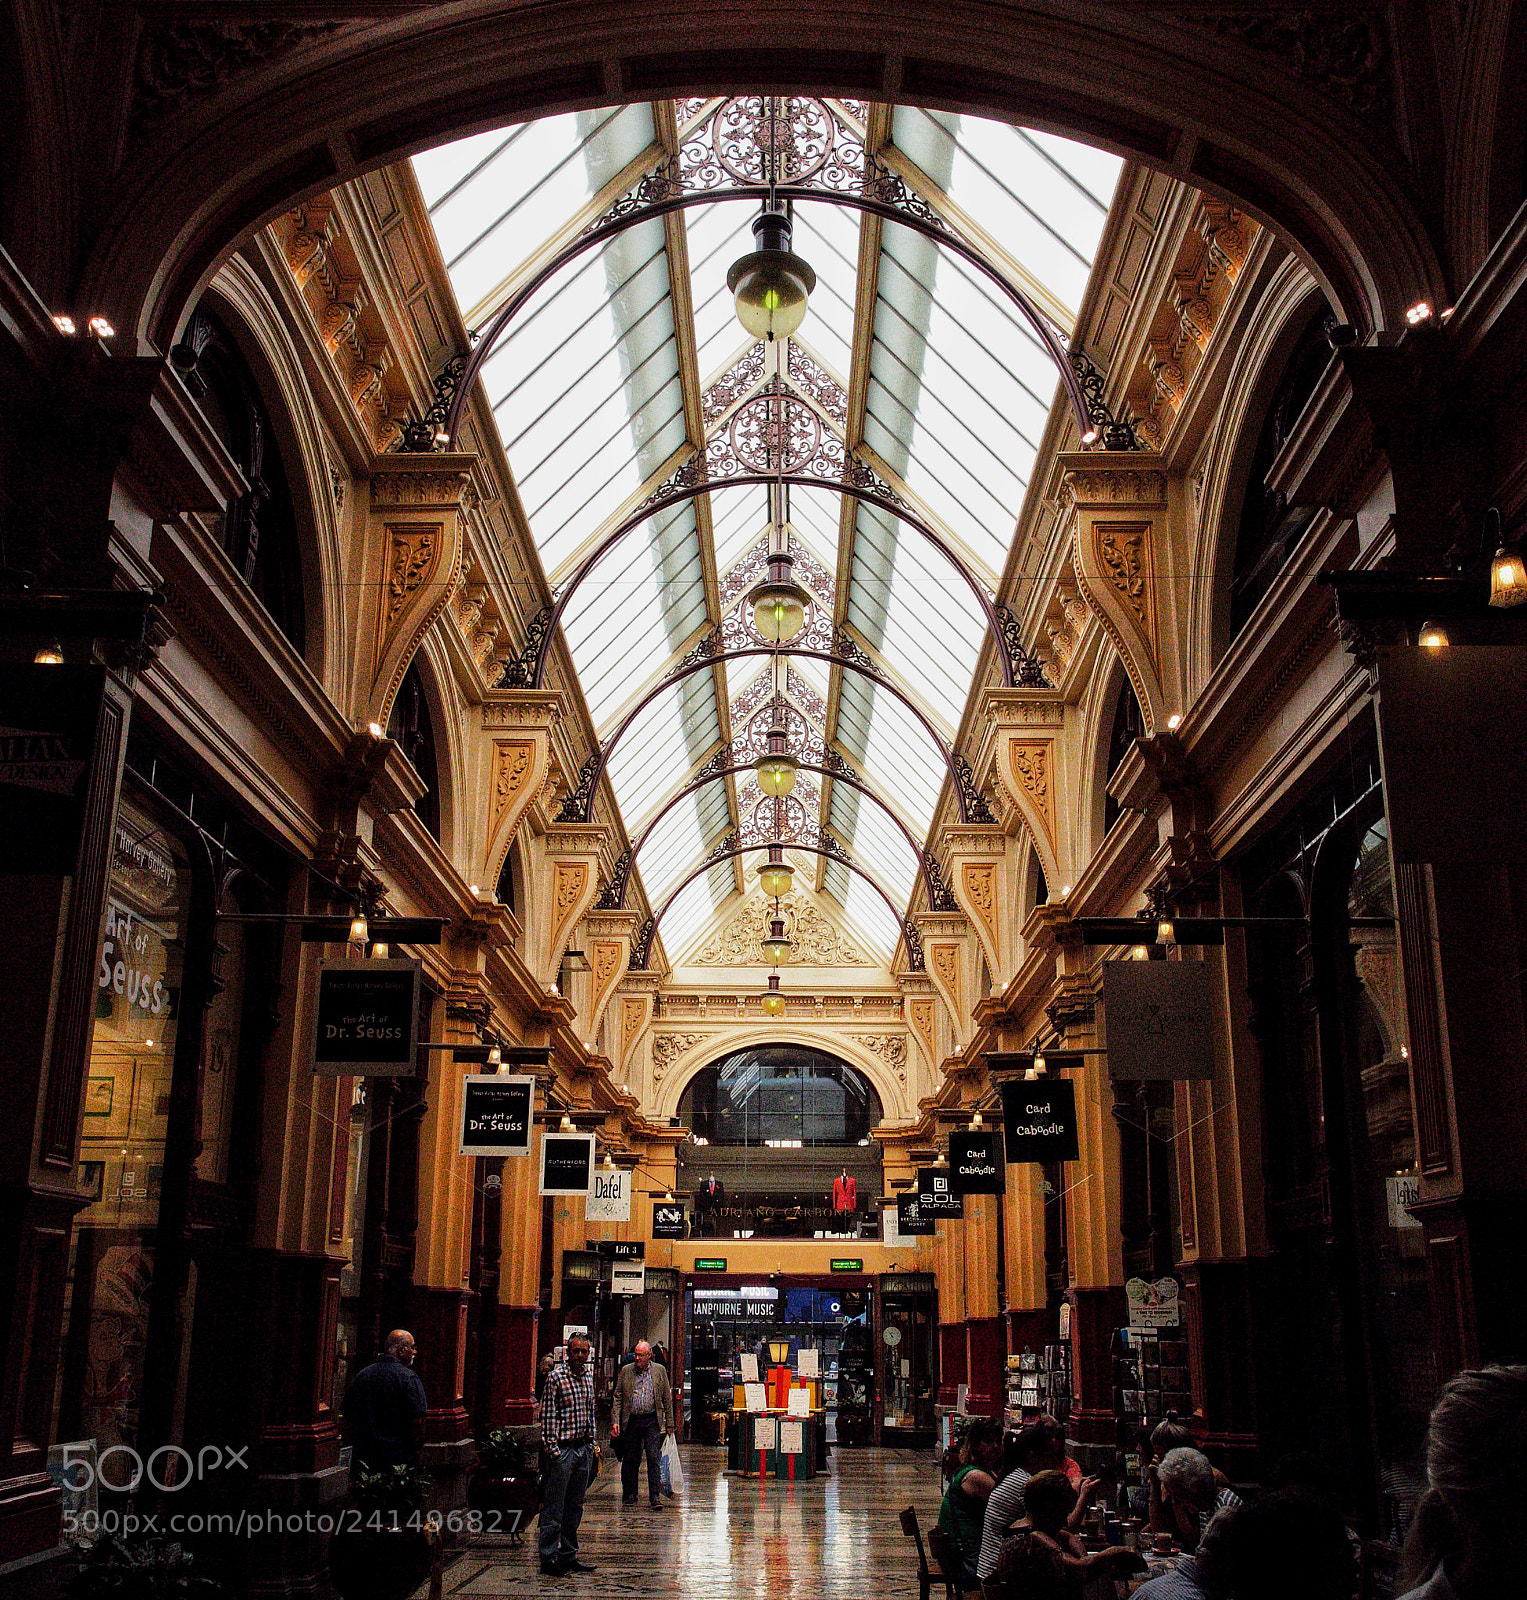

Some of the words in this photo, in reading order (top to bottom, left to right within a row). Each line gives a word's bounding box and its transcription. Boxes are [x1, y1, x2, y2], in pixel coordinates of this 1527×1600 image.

[0, 738, 71, 760] LIAN
[105, 904, 132, 945] Art
[135, 933, 150, 954] of
[99, 941, 164, 1014] Seuss
[359, 1013, 376, 1023] Art
[379, 1015, 389, 1023] of
[326, 1024, 350, 1039] Dr.
[356, 1024, 402, 1039] Seuss
[1026, 1103, 1051, 1114] Card
[492, 1112, 505, 1120] Art
[470, 1119, 487, 1130] Dr.
[490, 1119, 522, 1131] Seuss
[1016, 1123, 1065, 1136] Caboodle
[966, 1149, 987, 1158] Card
[958, 1165, 996, 1176] Caboodle
[594, 1174, 622, 1199] Dafel
[920, 1193, 961, 1203] SOL
[709, 1206, 776, 1218] ADRIANO
[783, 1206, 853, 1218] CARBONE
[615, 1245, 630, 1254] Lift
[632, 1246, 637, 1254] 3
[747, 1303, 775, 1316] MUSIC
